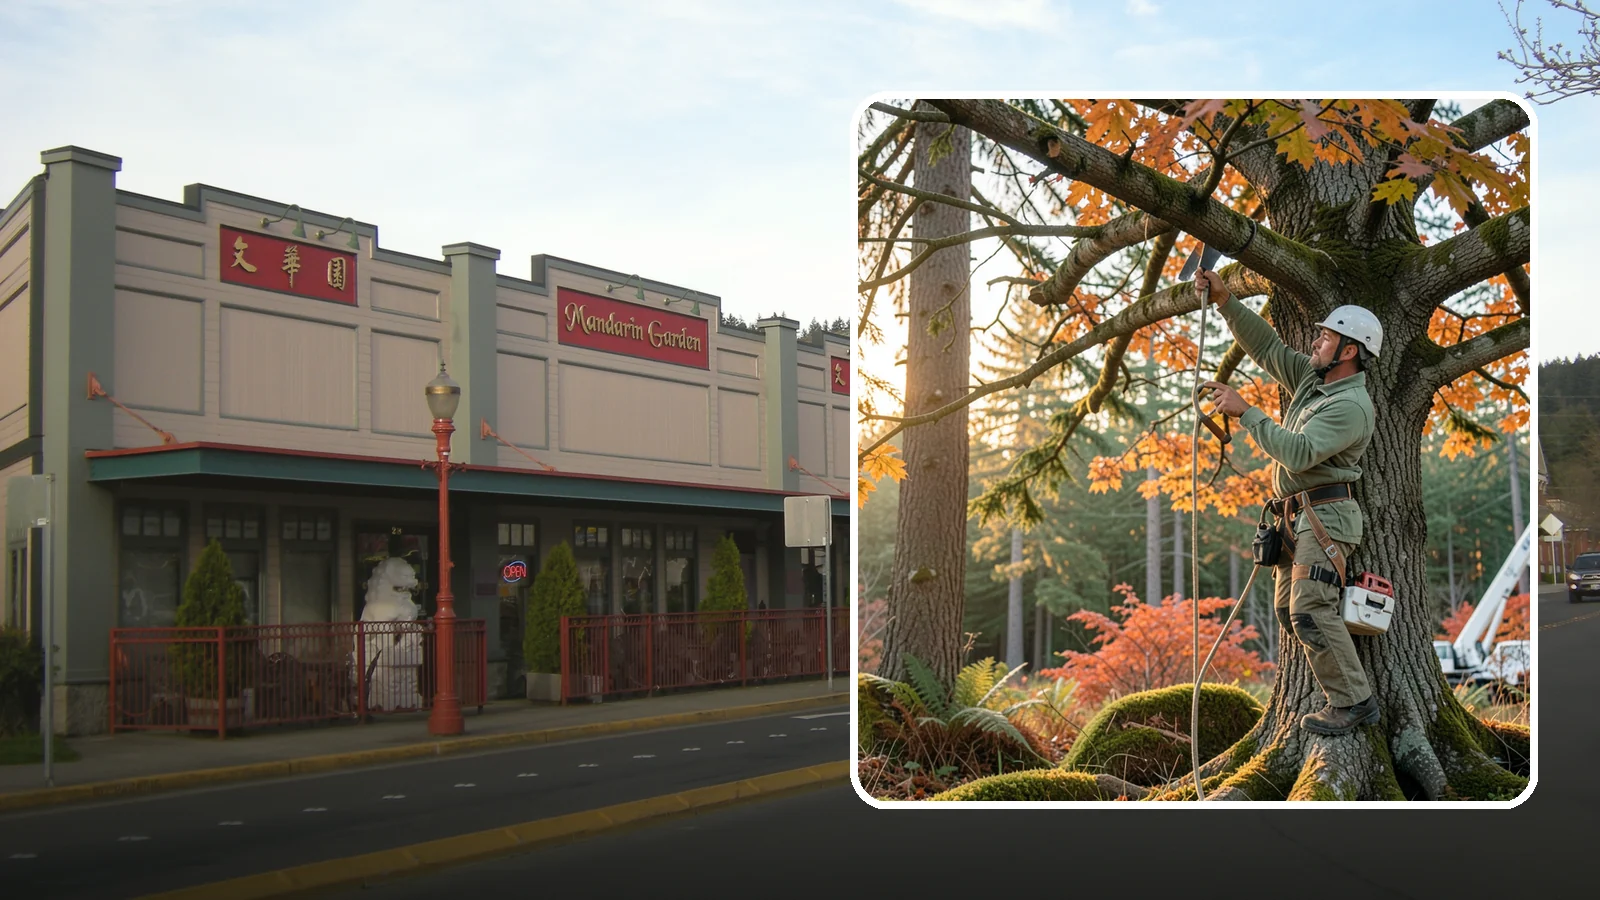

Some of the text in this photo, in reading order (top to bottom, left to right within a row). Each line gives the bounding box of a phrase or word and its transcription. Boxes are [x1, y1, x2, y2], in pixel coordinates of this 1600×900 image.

[231, 235, 346, 290] 文華園
[564, 301, 702, 352] Mandarin Garden
[834, 363, 846, 386] 文
[503, 565, 527, 578] OPEN
